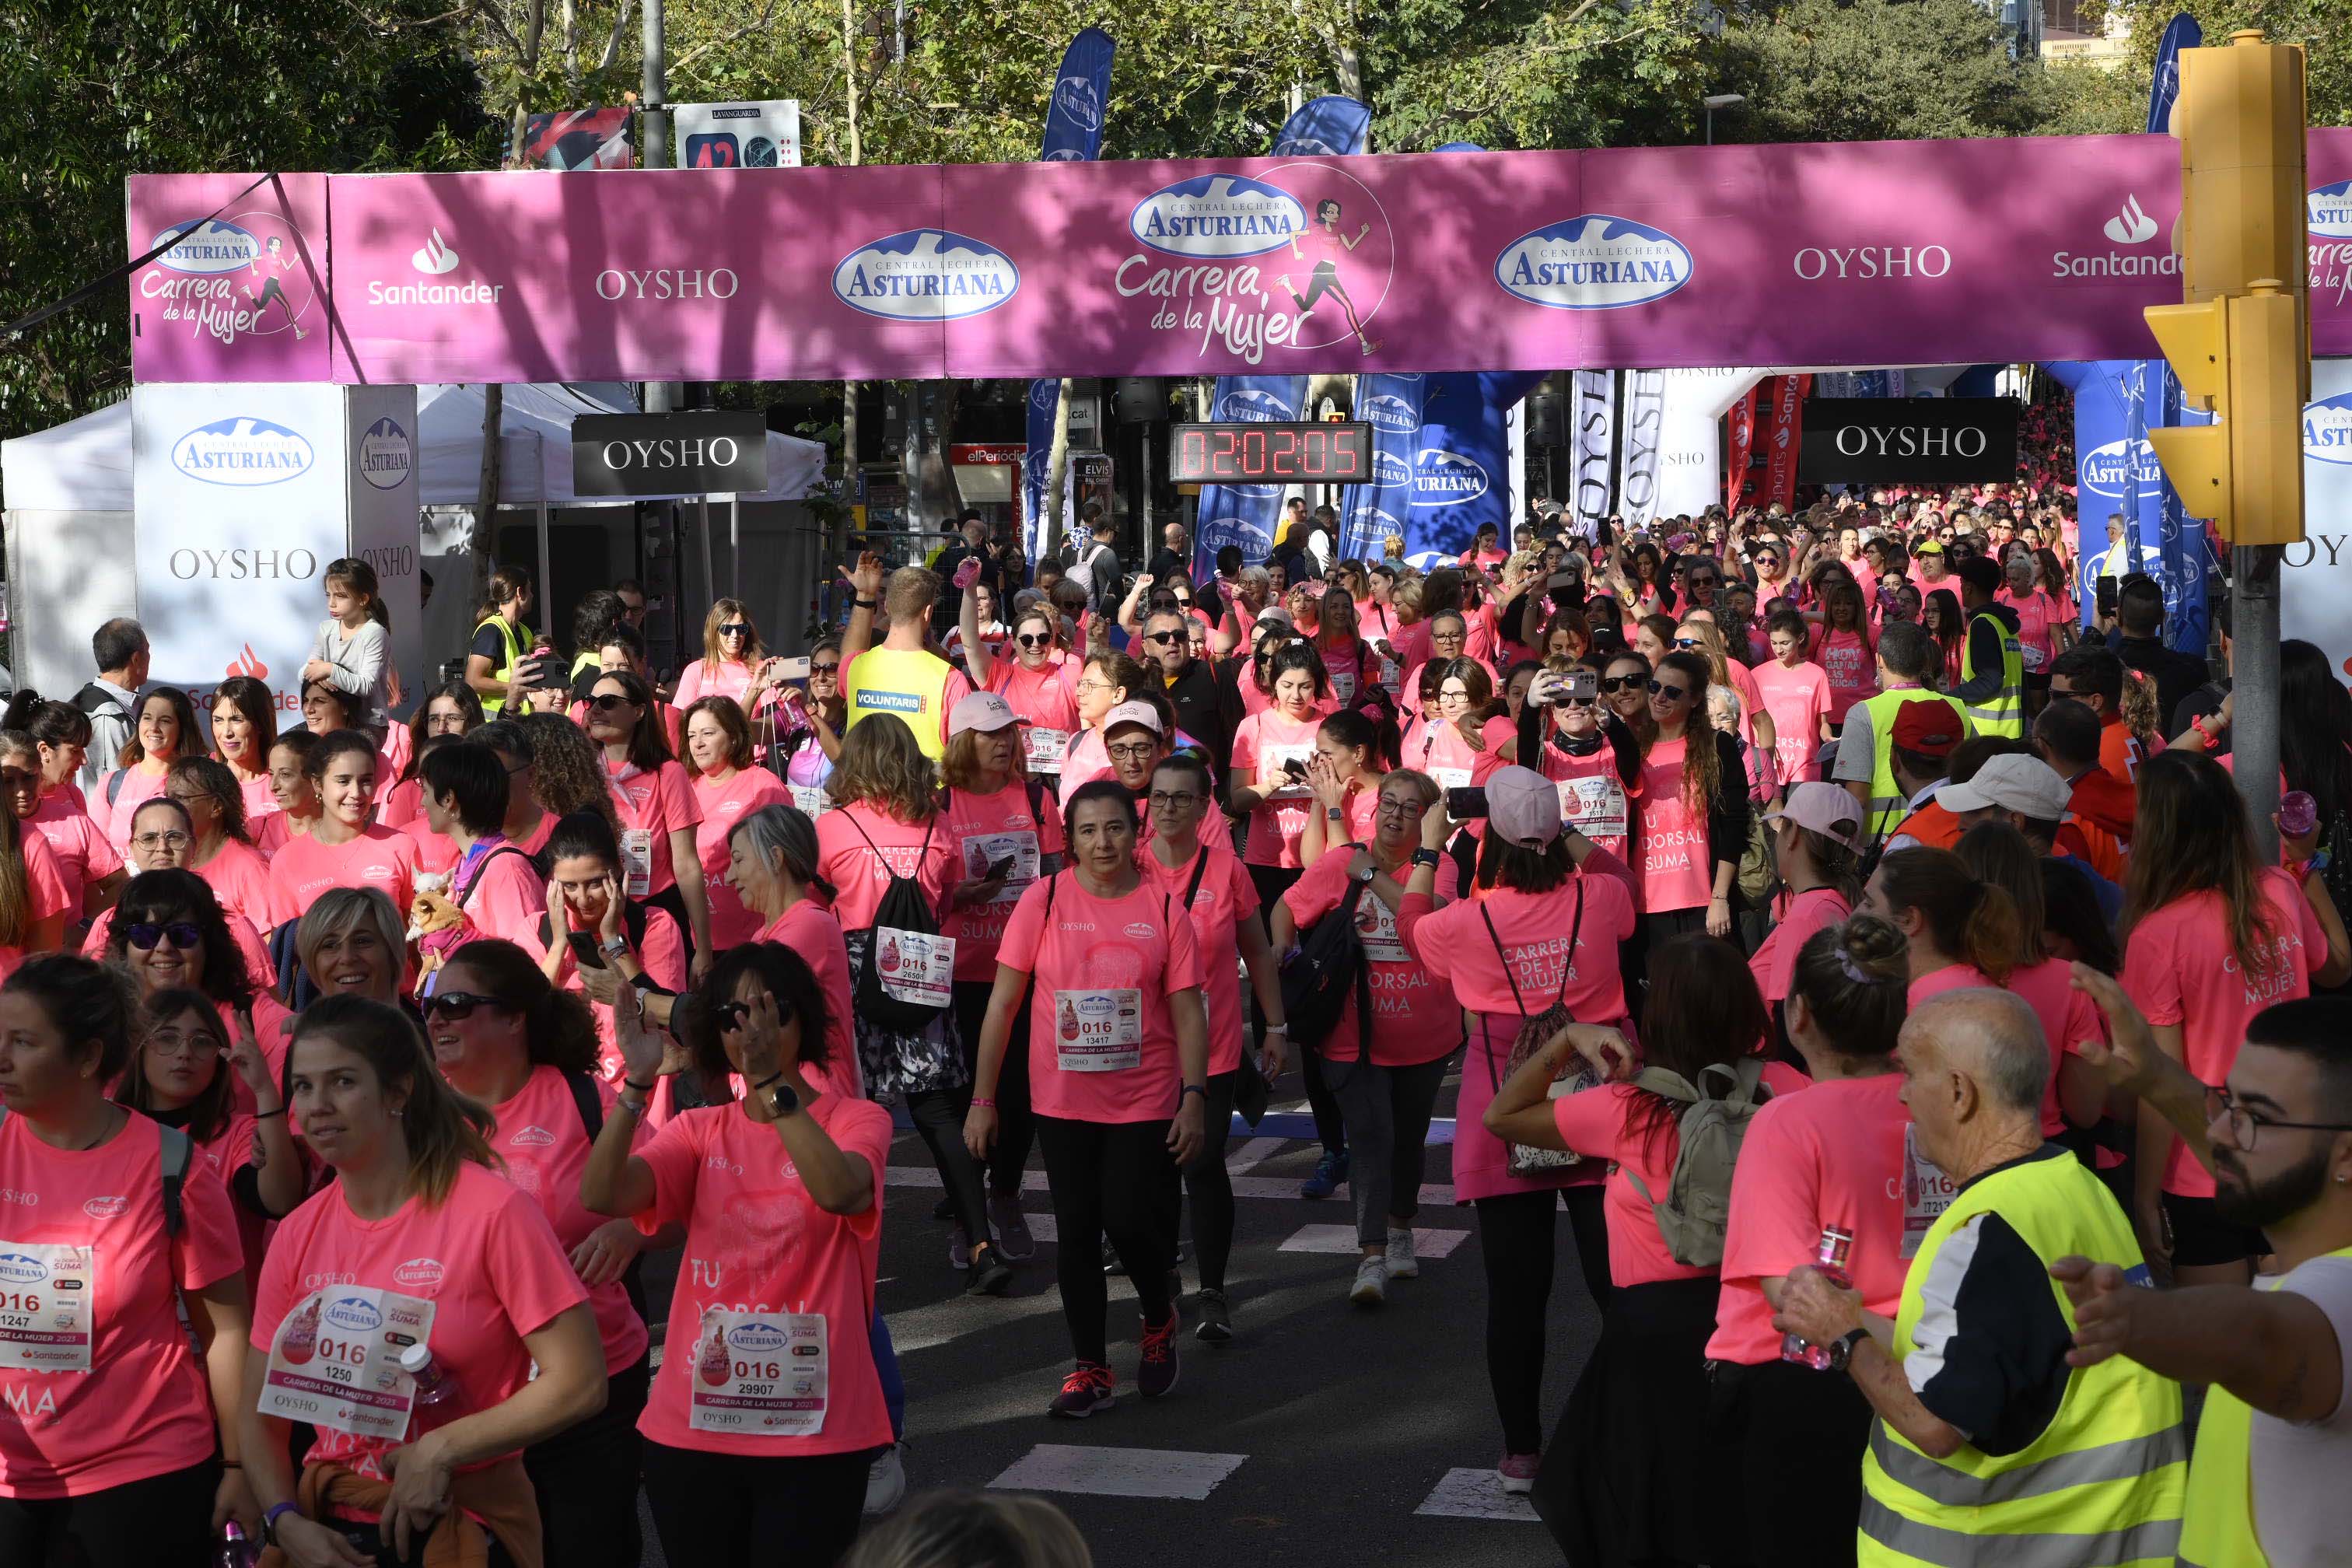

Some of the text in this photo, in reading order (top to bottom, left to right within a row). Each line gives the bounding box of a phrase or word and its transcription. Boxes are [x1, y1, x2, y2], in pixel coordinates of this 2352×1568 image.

[722, 110, 760, 118] VANGUARDIA
[1171, 202, 1288, 212] CENTRAL LECHERA
[1144, 206, 1292, 237] ASTURIANA
[159, 239, 251, 259] ASTURIANA
[1541, 247, 1671, 257] CENTRAL LECHERA
[2308, 243, 2352, 265] arre
[876, 260, 999, 270] CENTRAL LECHERA
[1510, 251, 1678, 286] ASTURIANA
[1794, 245, 1951, 279] OYSHO
[2053, 251, 2183, 277] Santand
[141, 270, 232, 299] Carrera
[595, 268, 738, 299] OYSHO
[847, 264, 1006, 297] ASTURIANA
[1115, 254, 1261, 297] Carrera
[2308, 267, 2340, 288] e la
[368, 280, 504, 305] Santander
[163, 292, 267, 345] de la Mujer
[1151, 292, 1315, 365] de la Mujer
[1362, 405, 1414, 429] ASTURIANA
[1836, 425, 1986, 457] OYSHO
[184, 443, 303, 467] ASTURIANA
[363, 445, 408, 472] ASTURIANA
[604, 437, 738, 470] OYSHO
[1183, 430, 1356, 474] 02:02:05
[1085, 465, 1109, 474] ELVIS
[1414, 476, 1482, 492] URIANA
[170, 549, 317, 579] OYSHO
[1825, 647, 1861, 661] HOY
[1826, 670, 1844, 678] LAS
[857, 694, 918, 709] VOLUNTARIS
[1776, 737, 1807, 749] ORSAL
[1265, 802, 1311, 816] DORSA
[1584, 799, 1607, 809] 016
[1643, 830, 1704, 850] DORSAL
[874, 856, 914, 867] DE LA
[1646, 852, 1690, 871] SUMA
[299, 877, 334, 894] OYSHO
[961, 921, 1003, 939] SUM
[1059, 922, 1095, 932] OYSHO
[1503, 936, 1585, 964] CARRERA
[902, 957, 927, 971] 016
[1520, 954, 1571, 975] DE LA
[1367, 971, 1430, 989] ORSAL
[1520, 968, 1578, 990] MUJER
[2245, 972, 2297, 1005] MUJER
[1082, 1021, 1112, 1034] 016
[1920, 1176, 1954, 1195] 016
[0, 1188, 38, 1206] SHO
[305, 1272, 355, 1288] OYSHO
[397, 1269, 442, 1280] ASTURIANA
[691, 1258, 721, 1288] TU
[327, 1307, 377, 1326] ASTURIANA
[389, 1313, 420, 1327] SUMA
[24, 1333, 54, 1342] MUJER
[731, 1332, 782, 1346] ASTURIANA
[33, 1350, 79, 1361] Santander
[319, 1338, 366, 1364] 016
[324, 1366, 352, 1382] 1250
[734, 1361, 780, 1379] 016
[282, 1376, 320, 1391] CARRERA
[322, 1384, 335, 1394] DE
[335, 1386, 345, 1395] LA
[345, 1388, 373, 1402] MUJER
[739, 1384, 775, 1395] 29907
[274, 1394, 319, 1413] OYSHO
[706, 1397, 740, 1406] CARRERA
[347, 1411, 395, 1426] Santander
[703, 1412, 742, 1425] OYSHO
[775, 1416, 815, 1426] Santander
